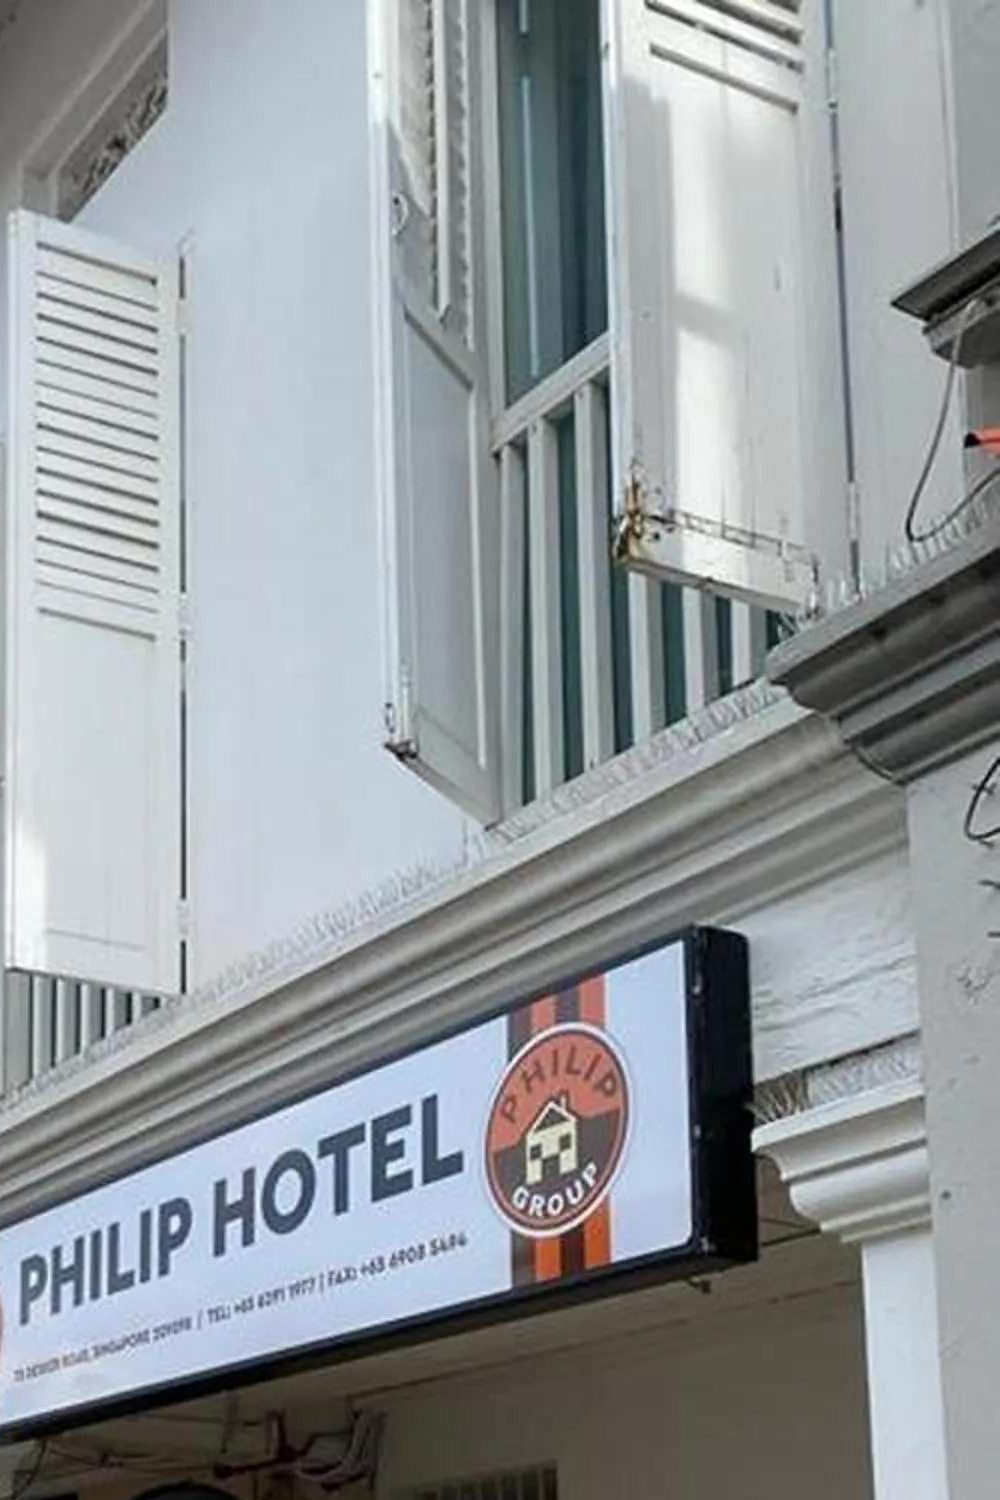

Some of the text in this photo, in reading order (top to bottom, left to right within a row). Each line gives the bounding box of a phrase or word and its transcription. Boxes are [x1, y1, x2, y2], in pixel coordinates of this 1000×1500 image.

[501, 1046, 619, 1124] PHILIP
[19, 1093, 465, 1327] PHILIP HOTEL
[511, 1162, 598, 1217] GROUP
